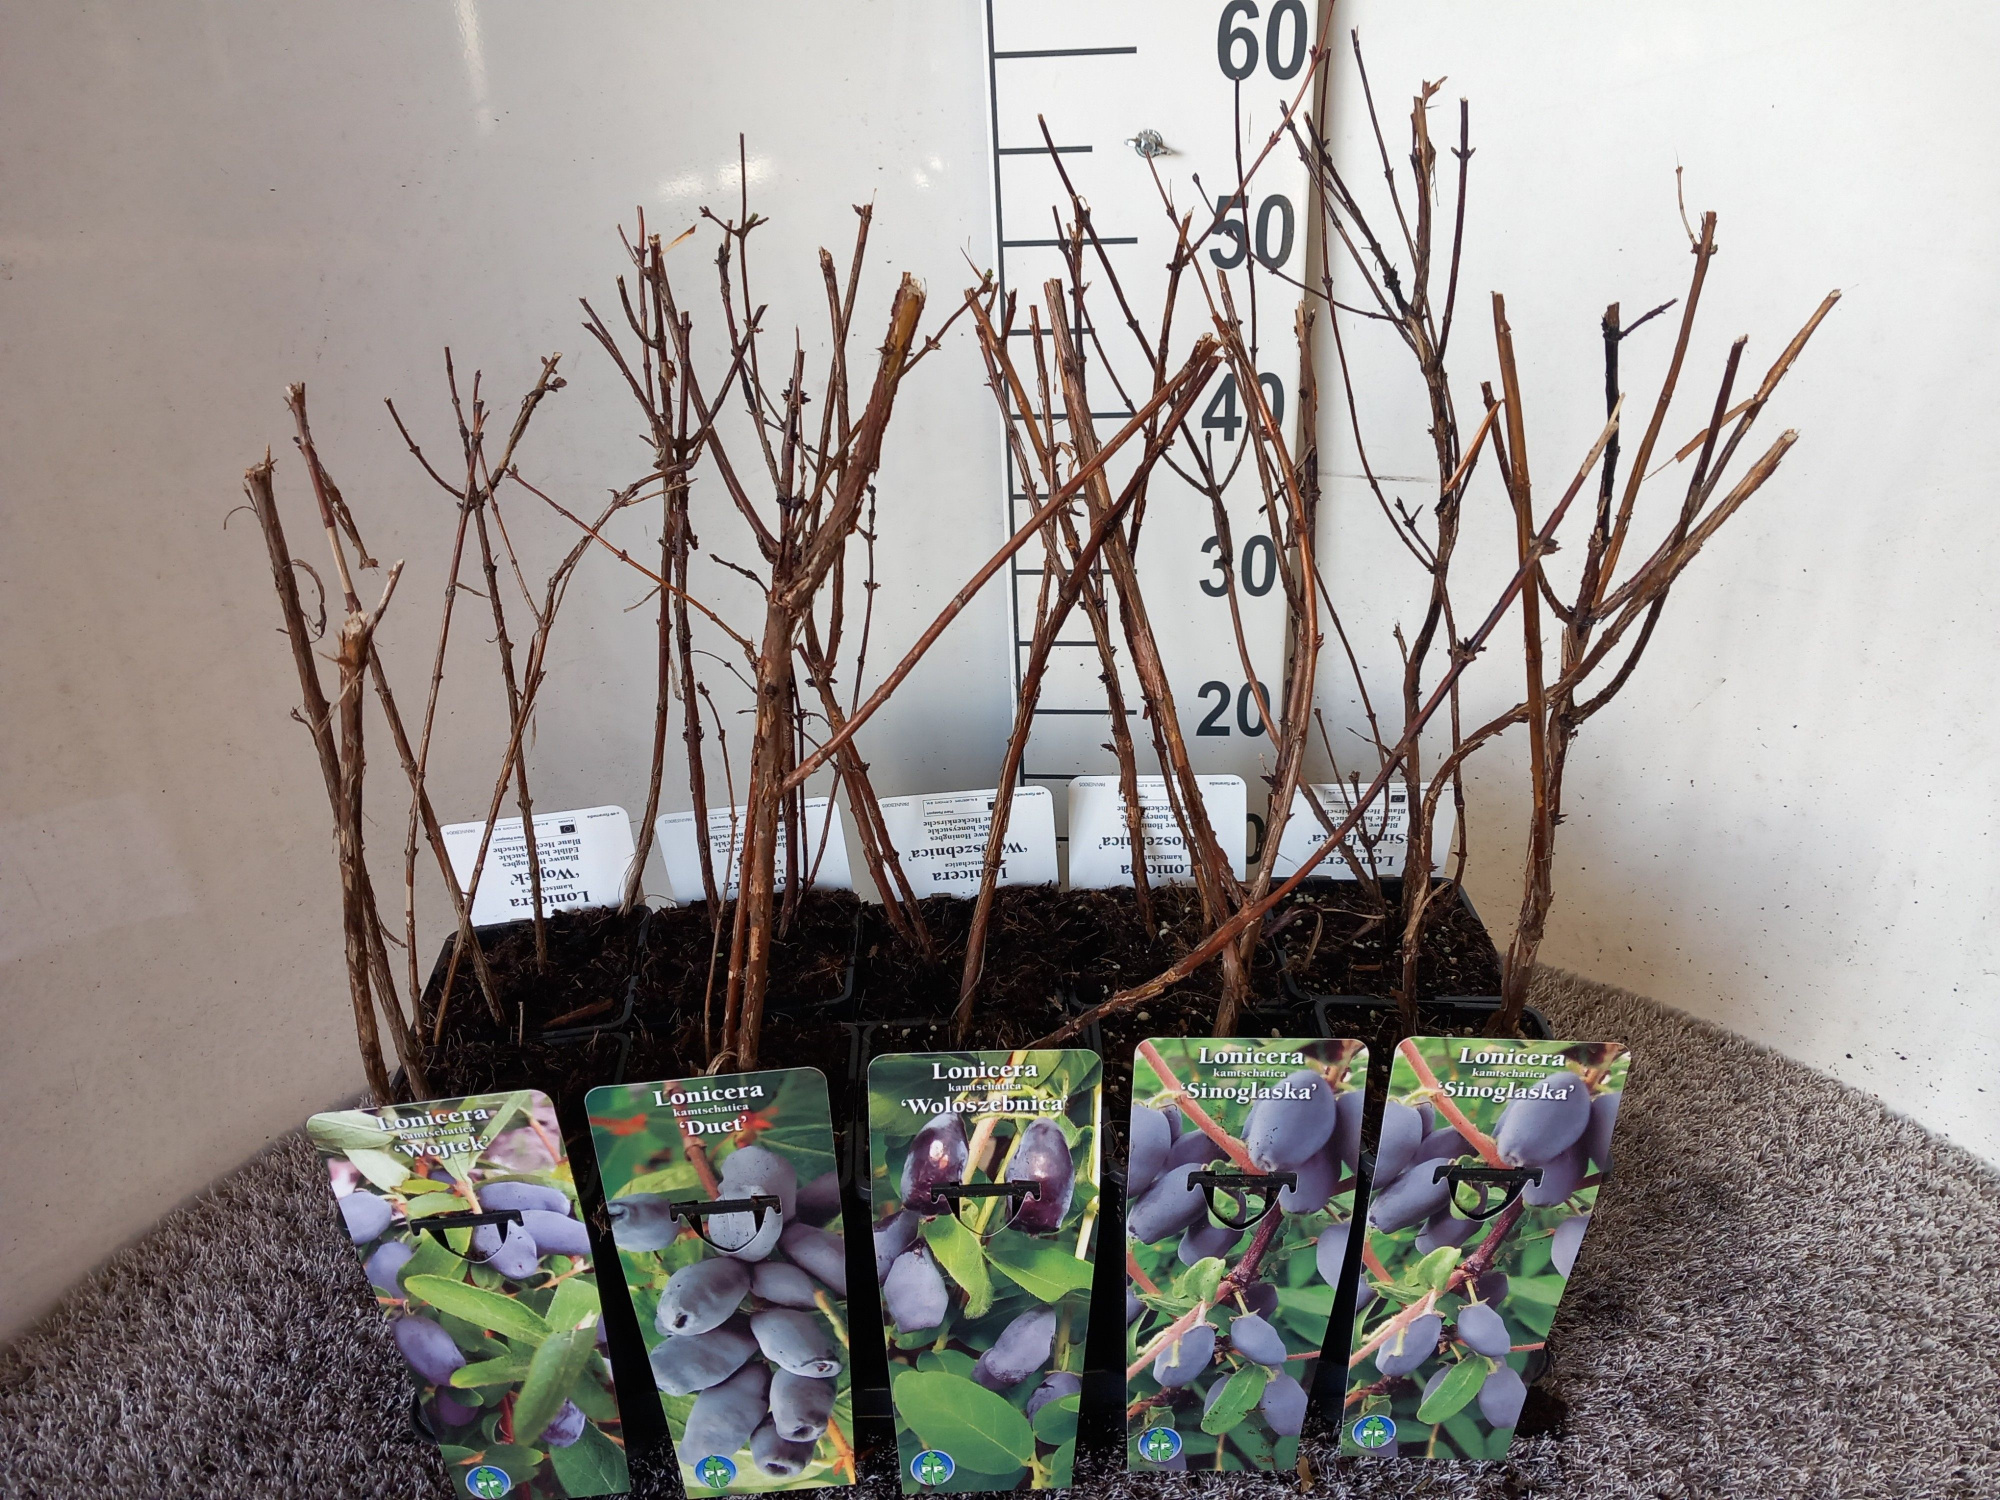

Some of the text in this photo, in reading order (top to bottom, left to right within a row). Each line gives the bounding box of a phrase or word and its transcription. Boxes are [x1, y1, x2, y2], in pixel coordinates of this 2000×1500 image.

[1217, 0, 1308, 81] 60
[1209, 194, 1294, 270] 50
[1201, 372, 1285, 442] 40
[1199, 535, 1277, 597] 30
[1196, 681, 1271, 737] 20
[923, 817, 981, 828] Heckenkirsche
[927, 824, 976, 835] honeysuckle
[557, 838, 581, 846] Blaue
[930, 832, 971, 842] Honingbes
[548, 854, 579, 863] Blauwe
[551, 846, 579, 855] Edible
[510, 867, 580, 886] ‘Wojek’
[931, 867, 1008, 882] Lnicera
[1198, 1046, 1305, 1065] Lonicera
[1458, 1047, 1566, 1067] Lonicera
[931, 1061, 1038, 1080] Lonicera
[1212, 1068, 1287, 1078] kamtschatica
[1471, 1067, 1547, 1079] kamtschatica
[652, 1084, 764, 1107] Lonicera
[948, 1082, 1022, 1092] kamtschatica
[672, 1103, 749, 1117] kamtschatica
[376, 1108, 489, 1132] Lonicera
[399, 1125, 476, 1142] kamtschatica
